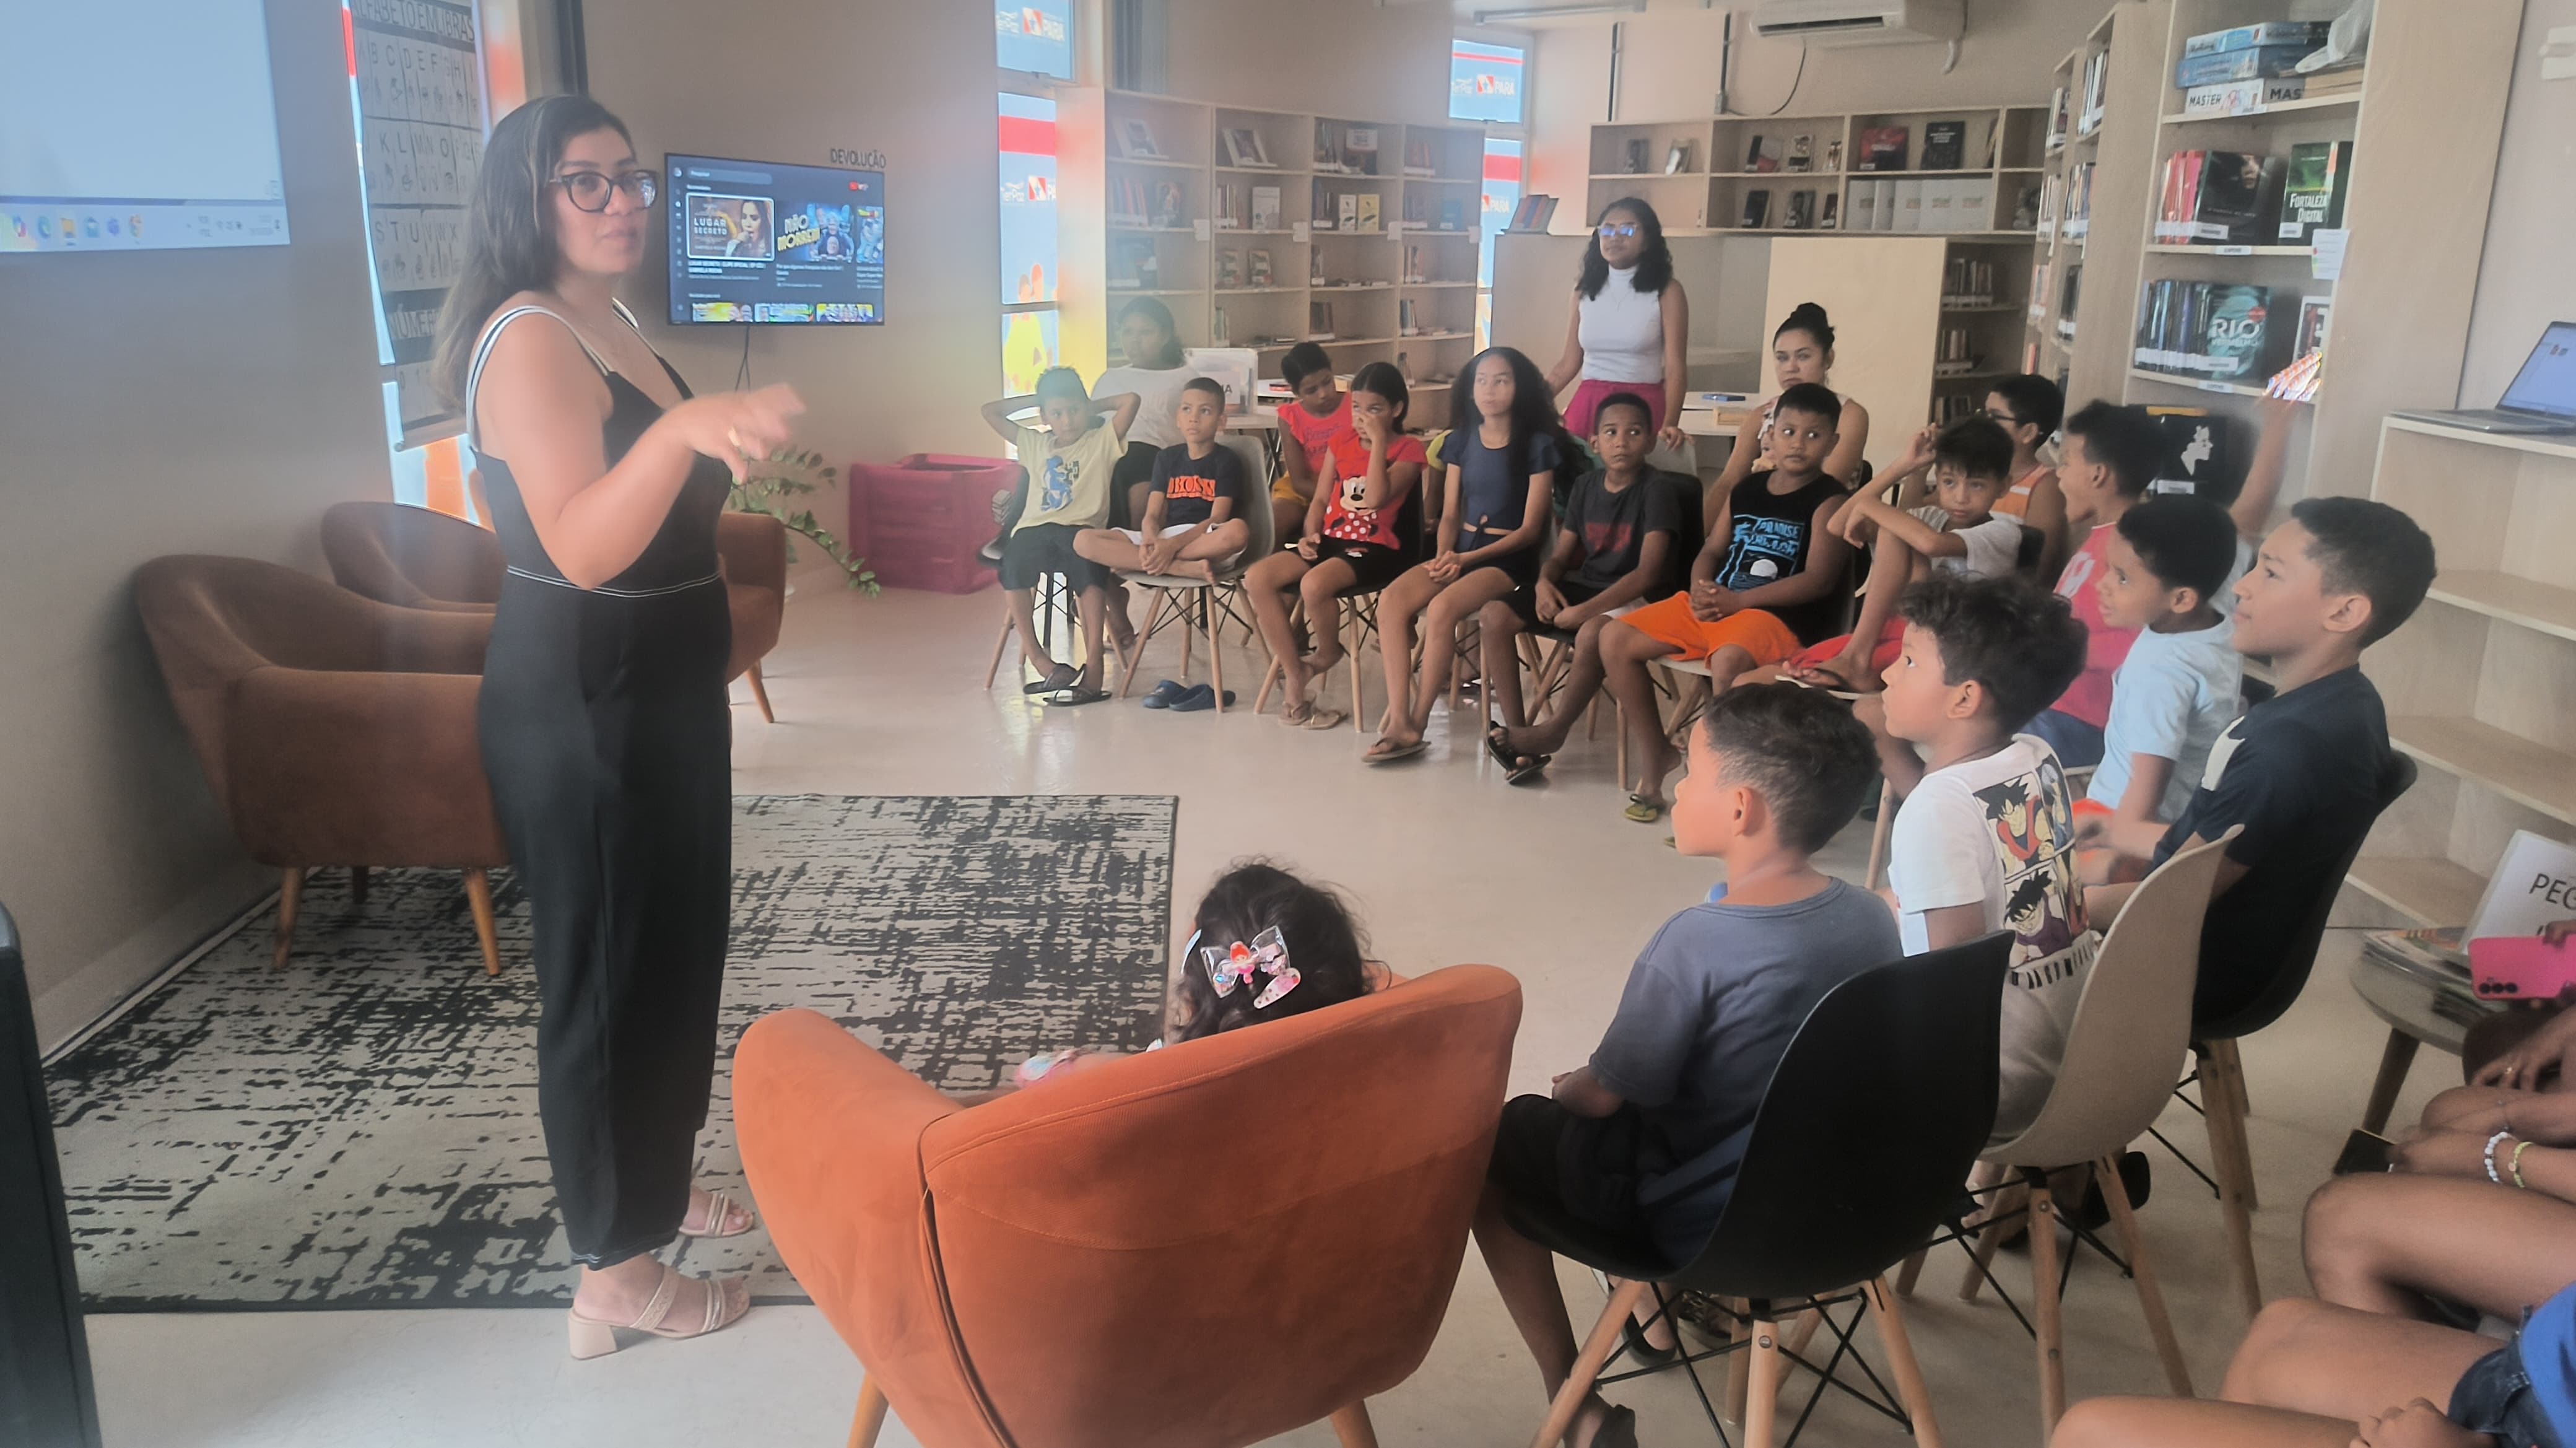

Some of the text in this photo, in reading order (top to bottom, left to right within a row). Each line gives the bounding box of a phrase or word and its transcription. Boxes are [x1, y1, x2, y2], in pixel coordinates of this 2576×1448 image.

[435, 8, 475, 41] LIBRAS
[2190, 94, 2222, 106] MASTER
[830, 148, 886, 169] DEVOLUÇÃO
[2290, 193, 2328, 208] FORTALEZA
[694, 218, 726, 227] LUGAR
[2297, 208, 2324, 223] DIGITAL
[388, 303, 437, 338] NÚMER
[2210, 318, 2260, 339] RIO
